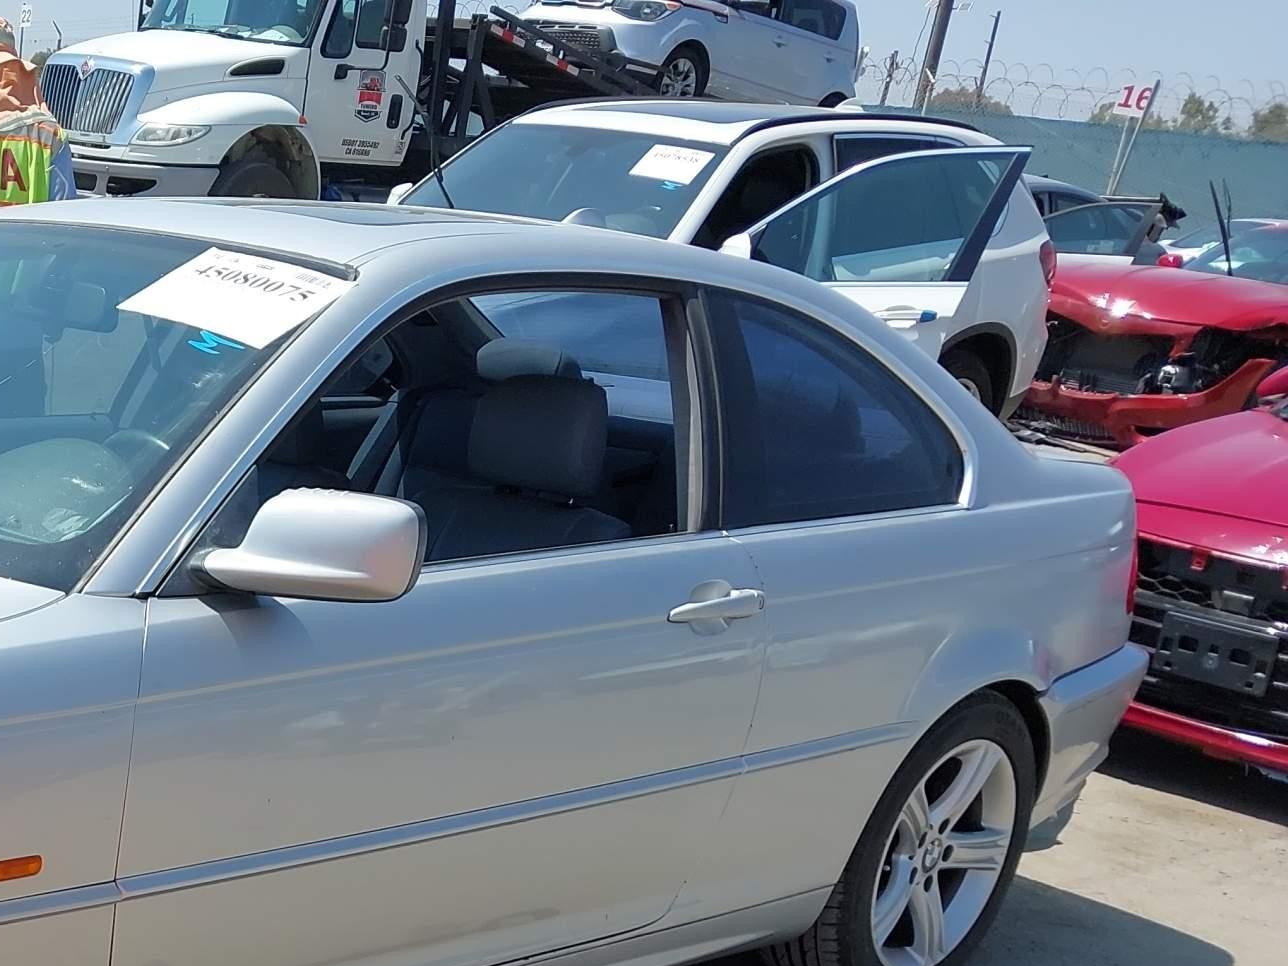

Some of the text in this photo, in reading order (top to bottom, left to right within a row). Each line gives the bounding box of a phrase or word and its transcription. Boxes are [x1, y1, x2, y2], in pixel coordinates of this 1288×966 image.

[21, 9, 32, 23] 22
[1116, 85, 1153, 111] 16
[194, 263, 317, 302] 45080075
